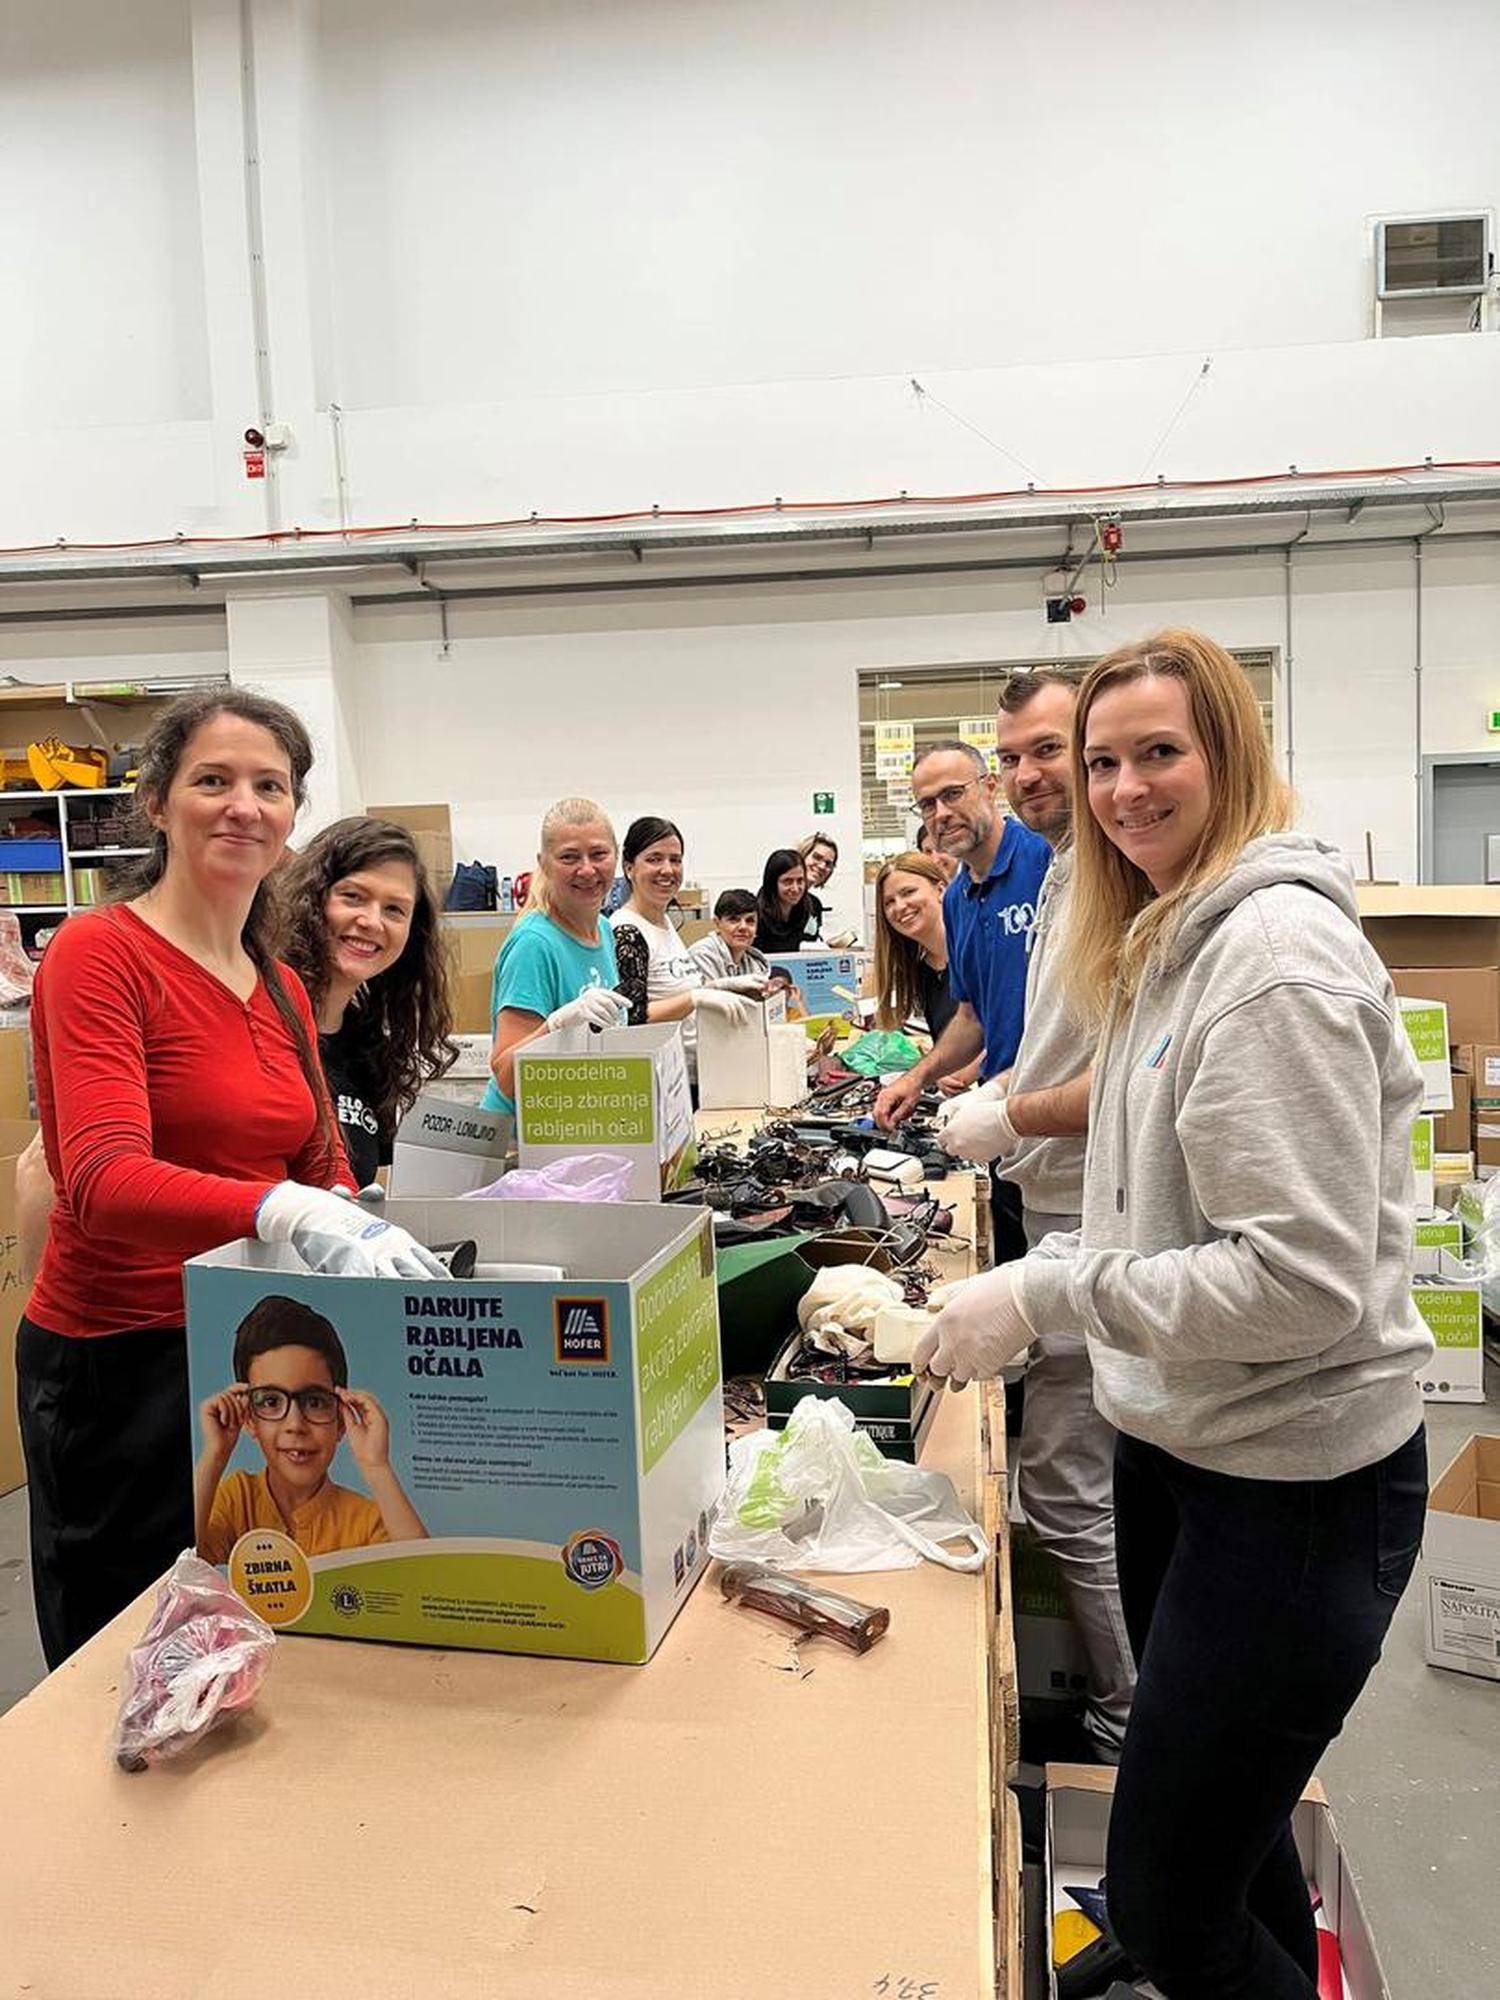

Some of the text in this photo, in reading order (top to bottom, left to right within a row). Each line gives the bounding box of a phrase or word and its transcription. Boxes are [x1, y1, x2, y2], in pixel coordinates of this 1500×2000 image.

[524, 1064, 627, 1081] Dobrodelna
[337, 1094, 363, 1111] SLO
[525, 1090, 649, 1113] akcija zbiranja
[338, 1108, 362, 1126] EX
[422, 1113, 454, 1135] POZOR
[527, 1117, 644, 1141] rabljenih očal
[639, 1250, 701, 1332] Dobrodeln
[404, 1296, 503, 1320] DARUJTE
[406, 1326, 523, 1351] RABLJENA
[563, 1338, 601, 1350] HOFER
[641, 1290, 714, 1393] akcija zbiranja
[408, 1348, 483, 1378] OČALA
[645, 1369, 696, 1451] rabljenih
[244, 1560, 292, 1575] ZBIRNA
[579, 1562, 609, 1577] JUTRI
[248, 1579, 297, 1595] ŠKATLA
